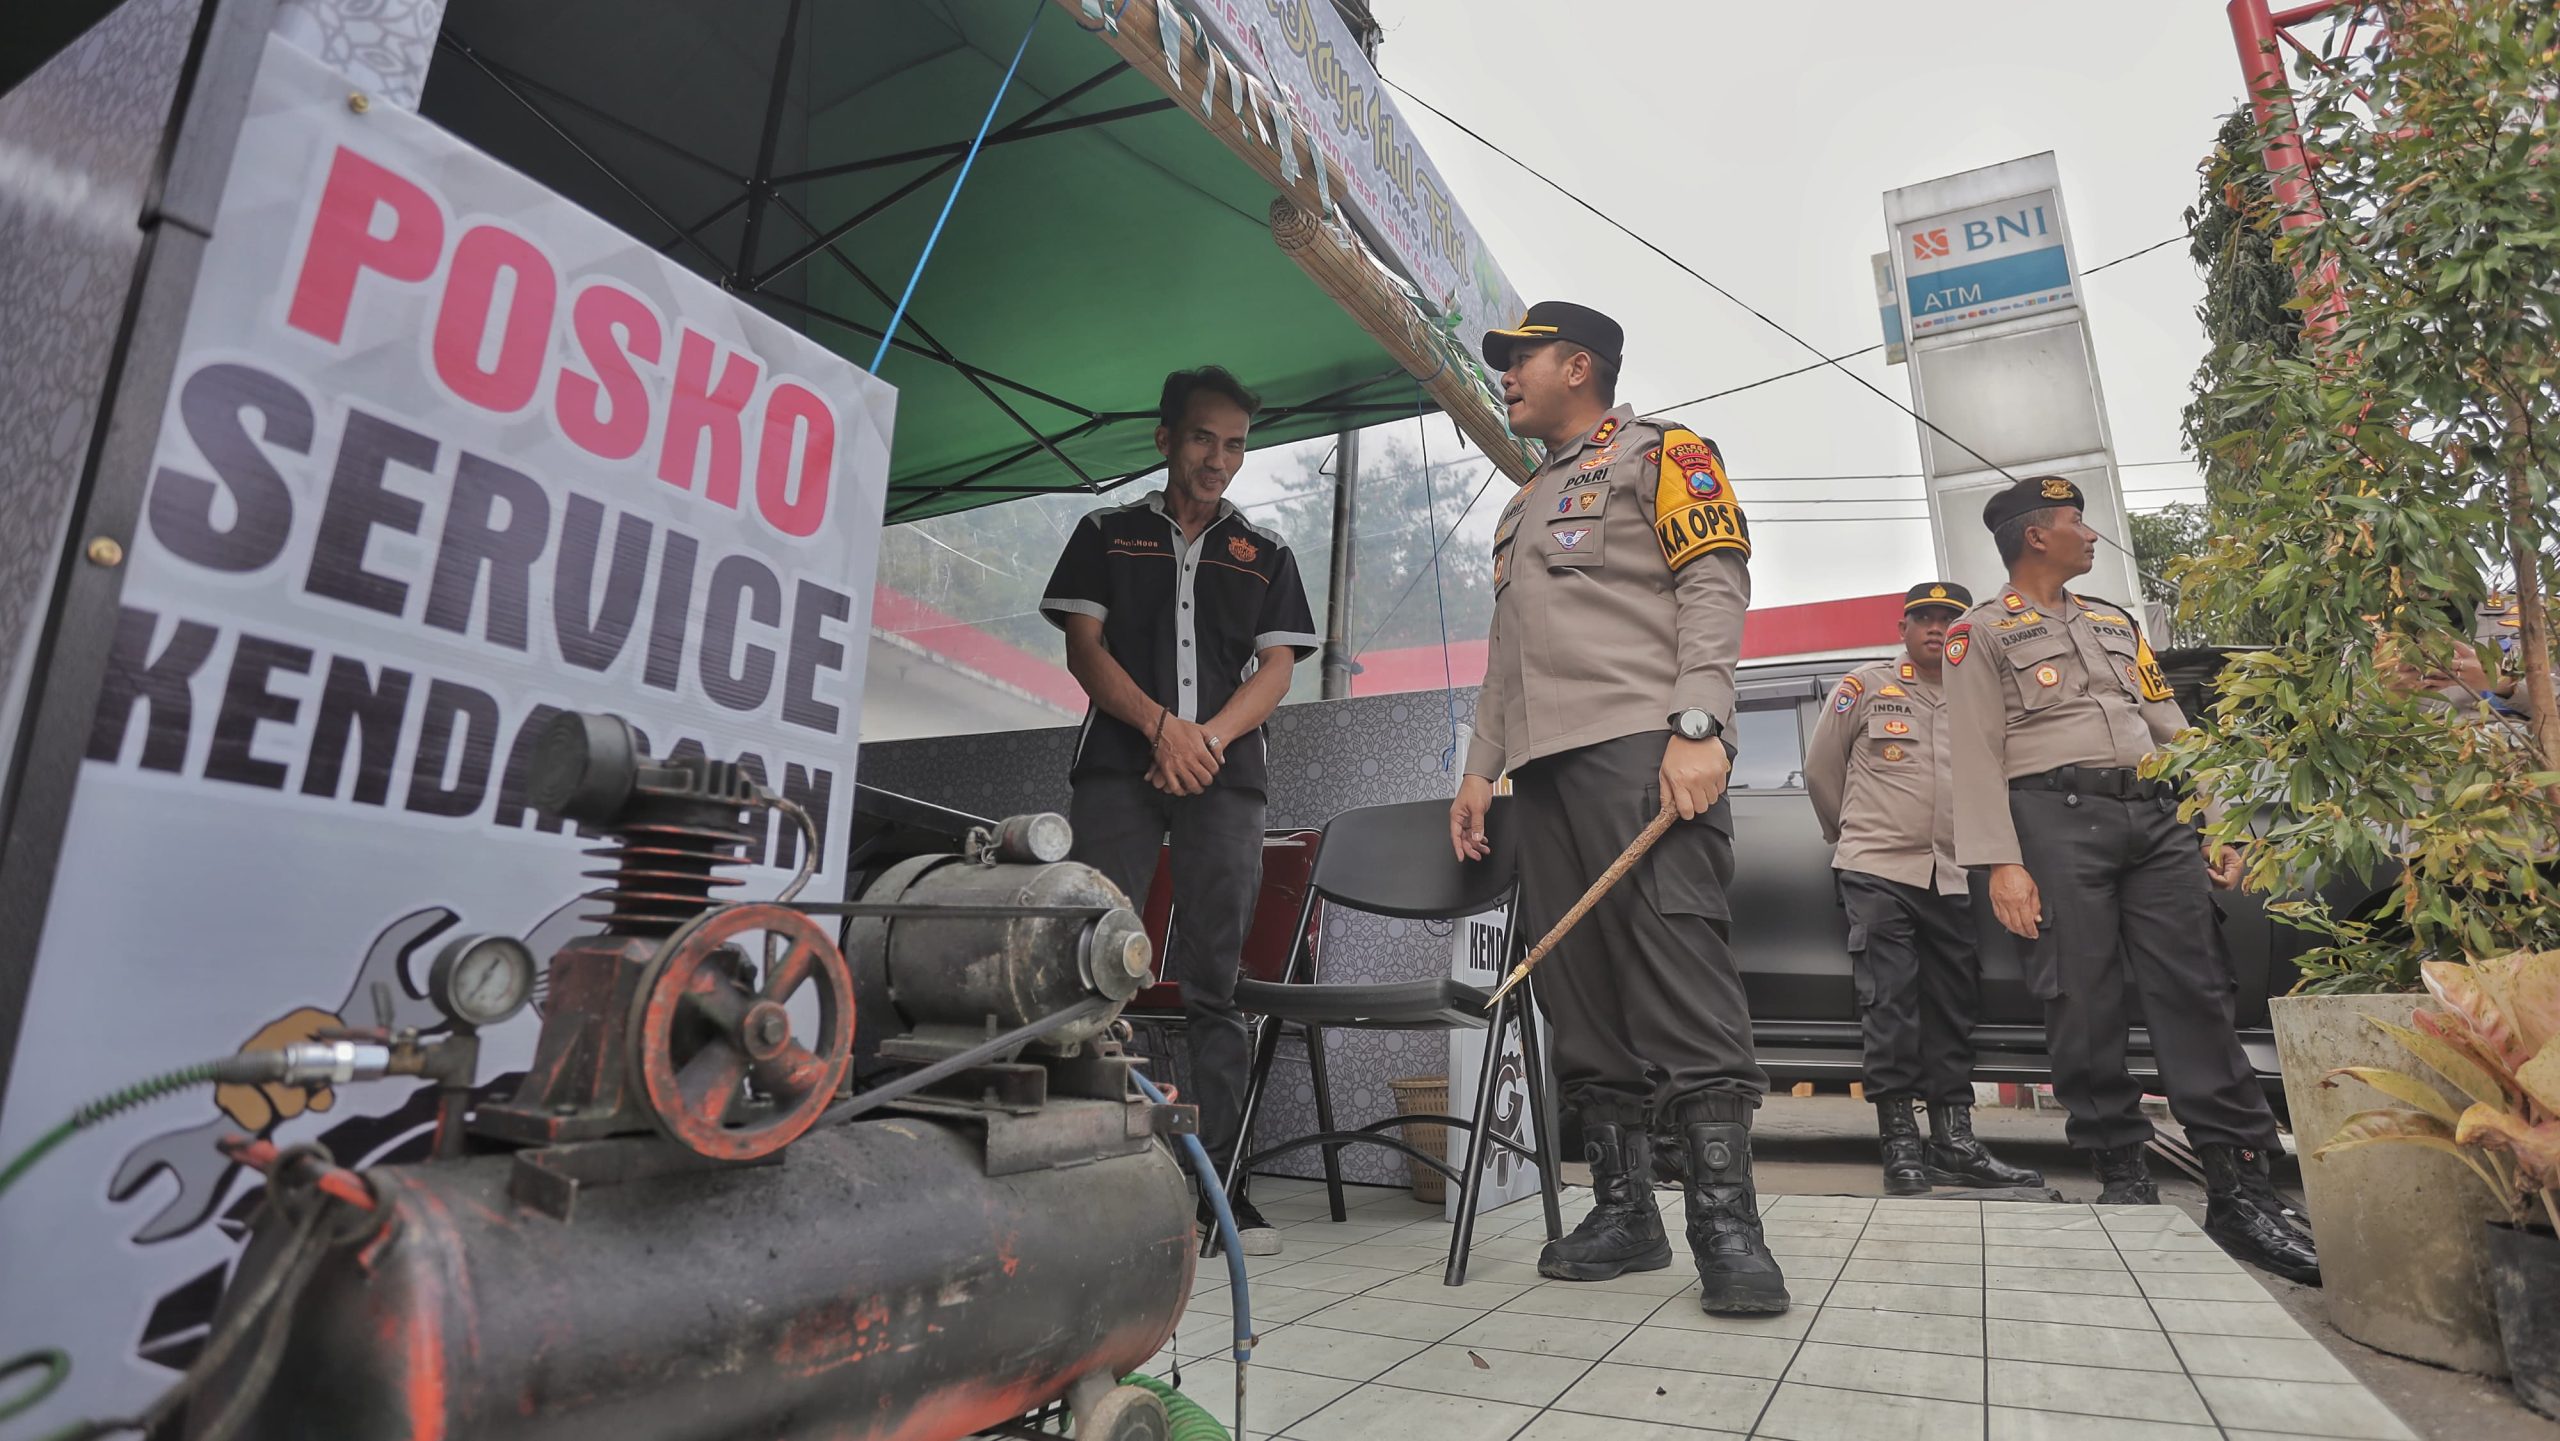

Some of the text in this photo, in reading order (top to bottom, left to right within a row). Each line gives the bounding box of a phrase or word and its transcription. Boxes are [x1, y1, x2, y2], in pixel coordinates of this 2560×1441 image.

[1385, 181, 1431, 259] 1446 H
[1963, 206, 2048, 251] BNI
[1924, 284, 1982, 312] ATM
[287, 145, 835, 538] POSKO
[1564, 468, 1608, 490] POLRI
[148, 362, 851, 735] SERVICE
[1659, 517, 1689, 558] KA
[1689, 505, 1735, 539] OPS
[2092, 625, 2133, 640] POLRI
[1874, 704, 1912, 714] INDRA
